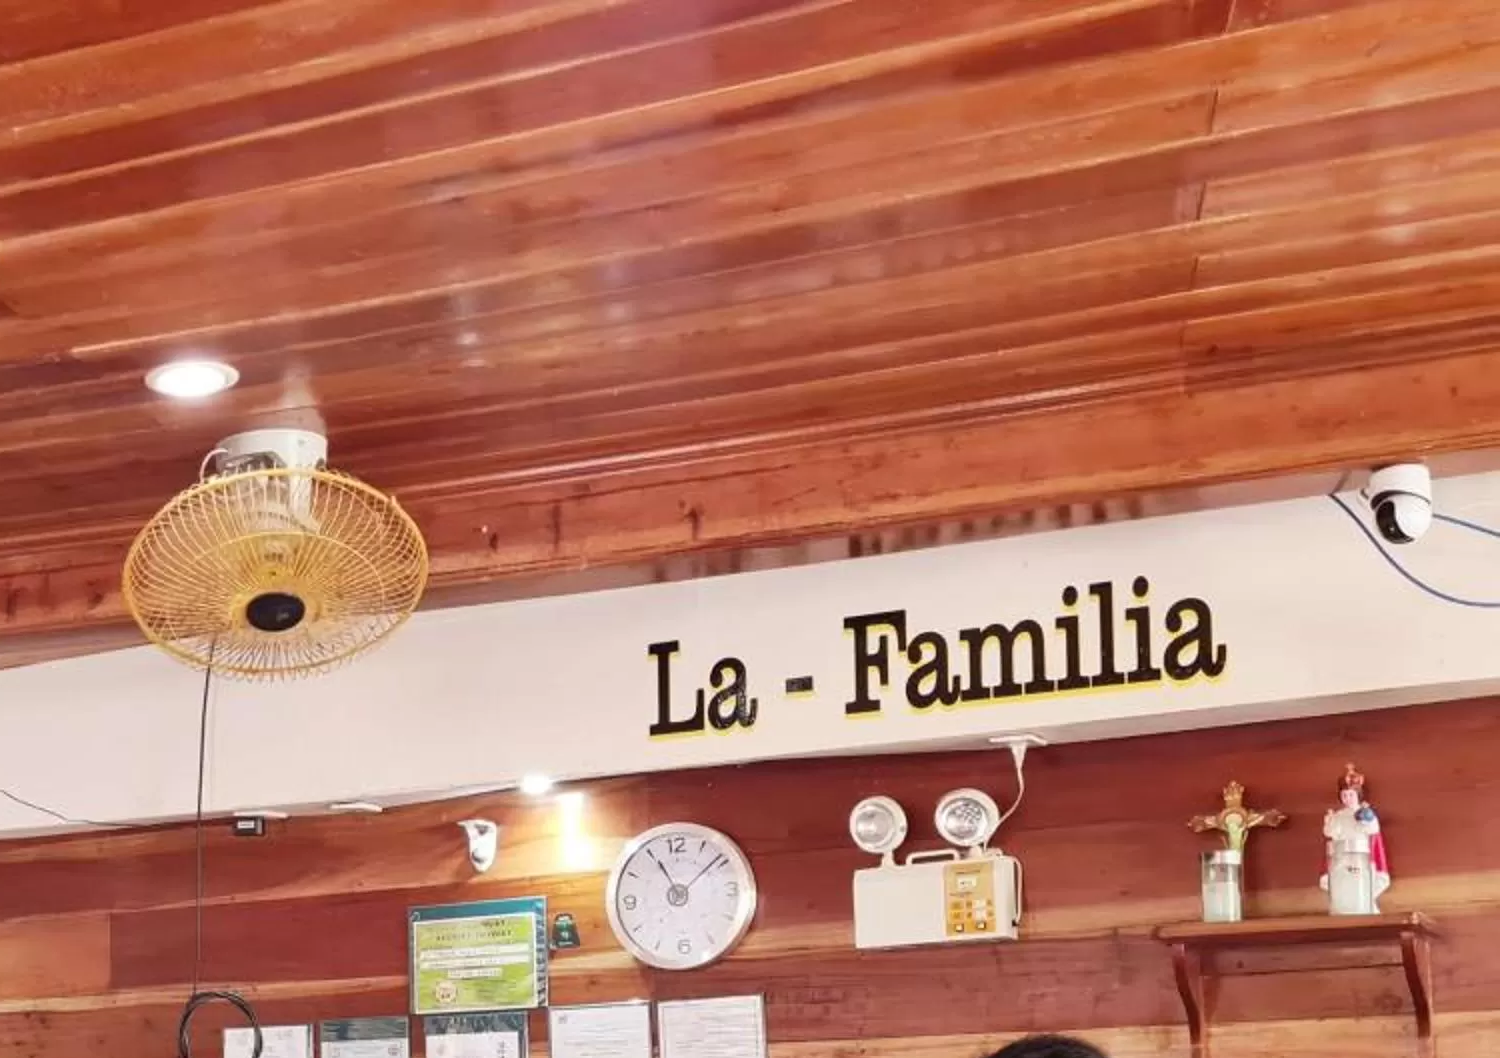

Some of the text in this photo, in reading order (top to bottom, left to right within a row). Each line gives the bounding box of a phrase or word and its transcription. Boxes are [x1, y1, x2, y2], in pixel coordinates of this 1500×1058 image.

[647, 640, 758, 737] La
[843, 575, 1227, 716] Familia
[667, 837, 687, 853] 12
[724, 881, 738, 897] 3
[623, 895, 637, 911] 9
[677, 939, 692, 954] 6
